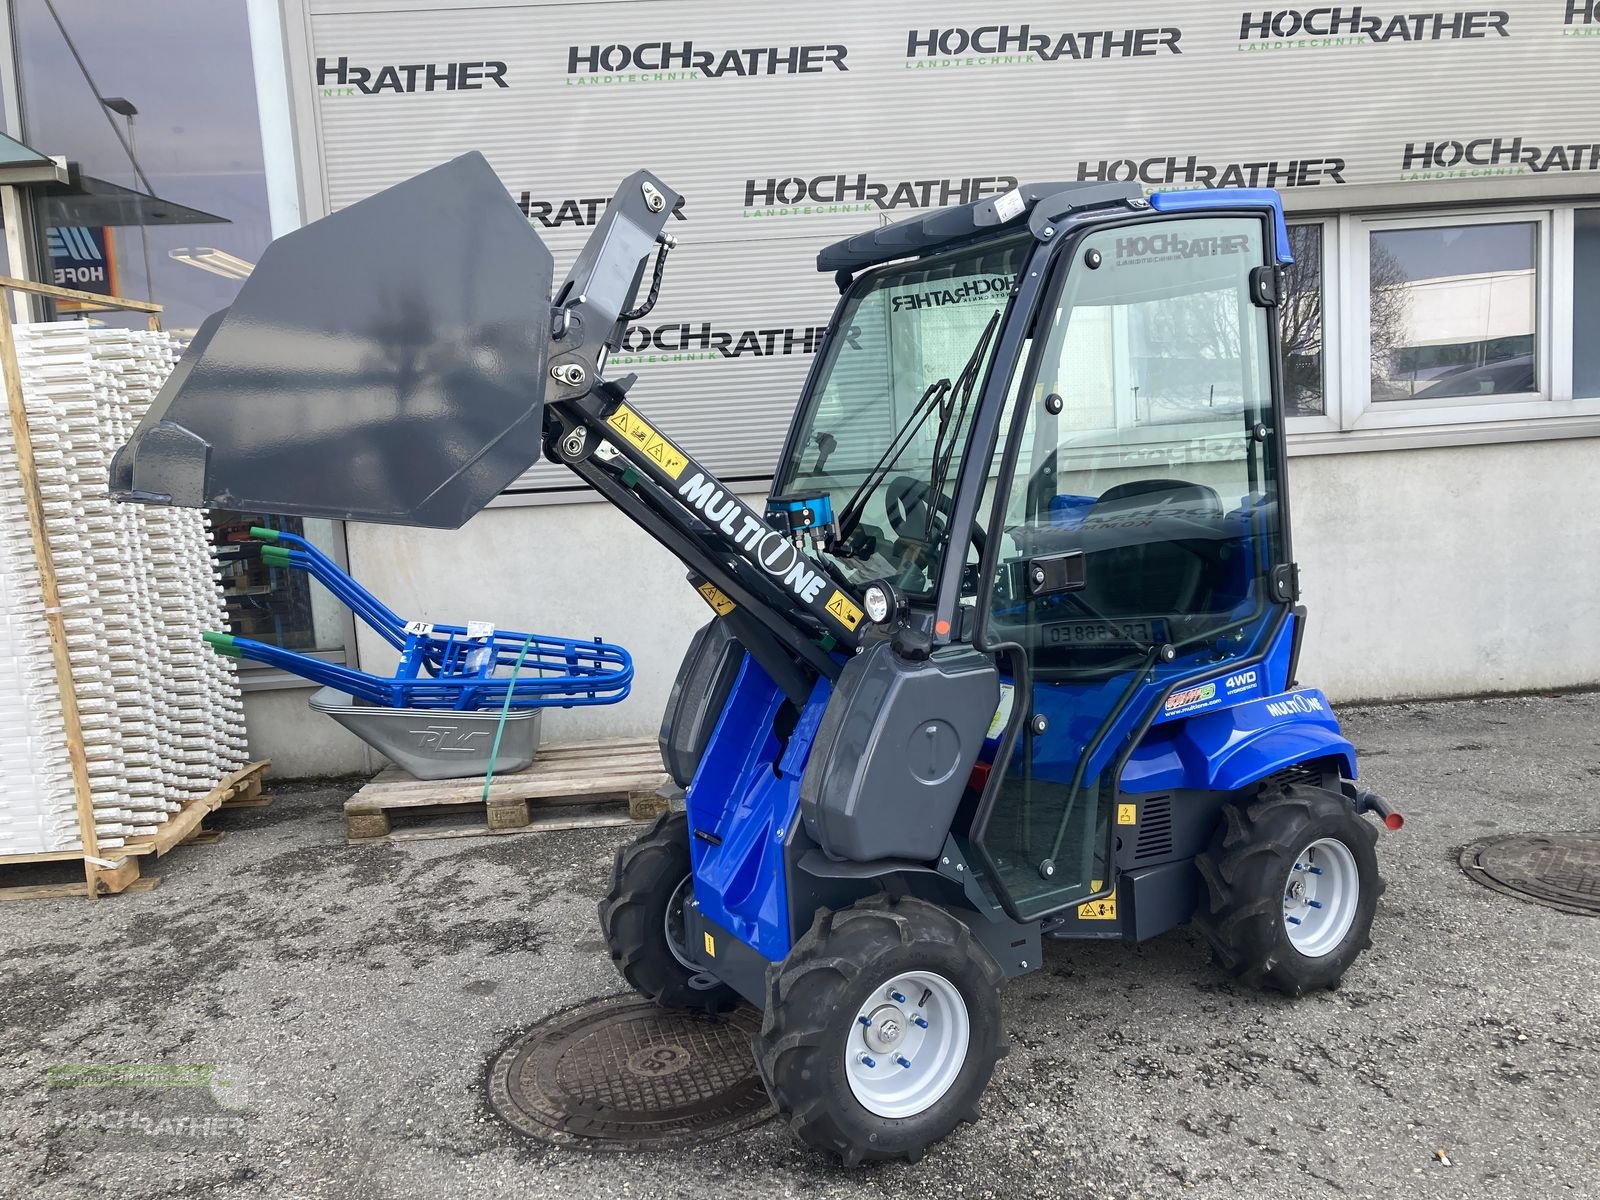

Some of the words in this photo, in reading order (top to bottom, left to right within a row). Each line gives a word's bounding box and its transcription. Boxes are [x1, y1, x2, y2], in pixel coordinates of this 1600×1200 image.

[1564, 0, 1600, 24] H
[1238, 6, 1511, 42] HOCHRATHER
[906, 24, 1183, 61] HOCHRATHER
[1238, 36, 1366, 51] LANDTECHNIK
[568, 41, 849, 78] HOCHRATHER
[905, 54, 1034, 69] LANDTECHNIK
[566, 71, 698, 85] LANDTECHNIK
[1077, 155, 1346, 189] HOCHRATHER
[1400, 165, 1527, 181] LANDTECHNIK
[743, 203, 873, 218] LANDTECHNIK
[1116, 233, 1250, 258] HOCHRATHER
[413, 622, 429, 633] AT
[1225, 671, 1257, 688] 4WD
